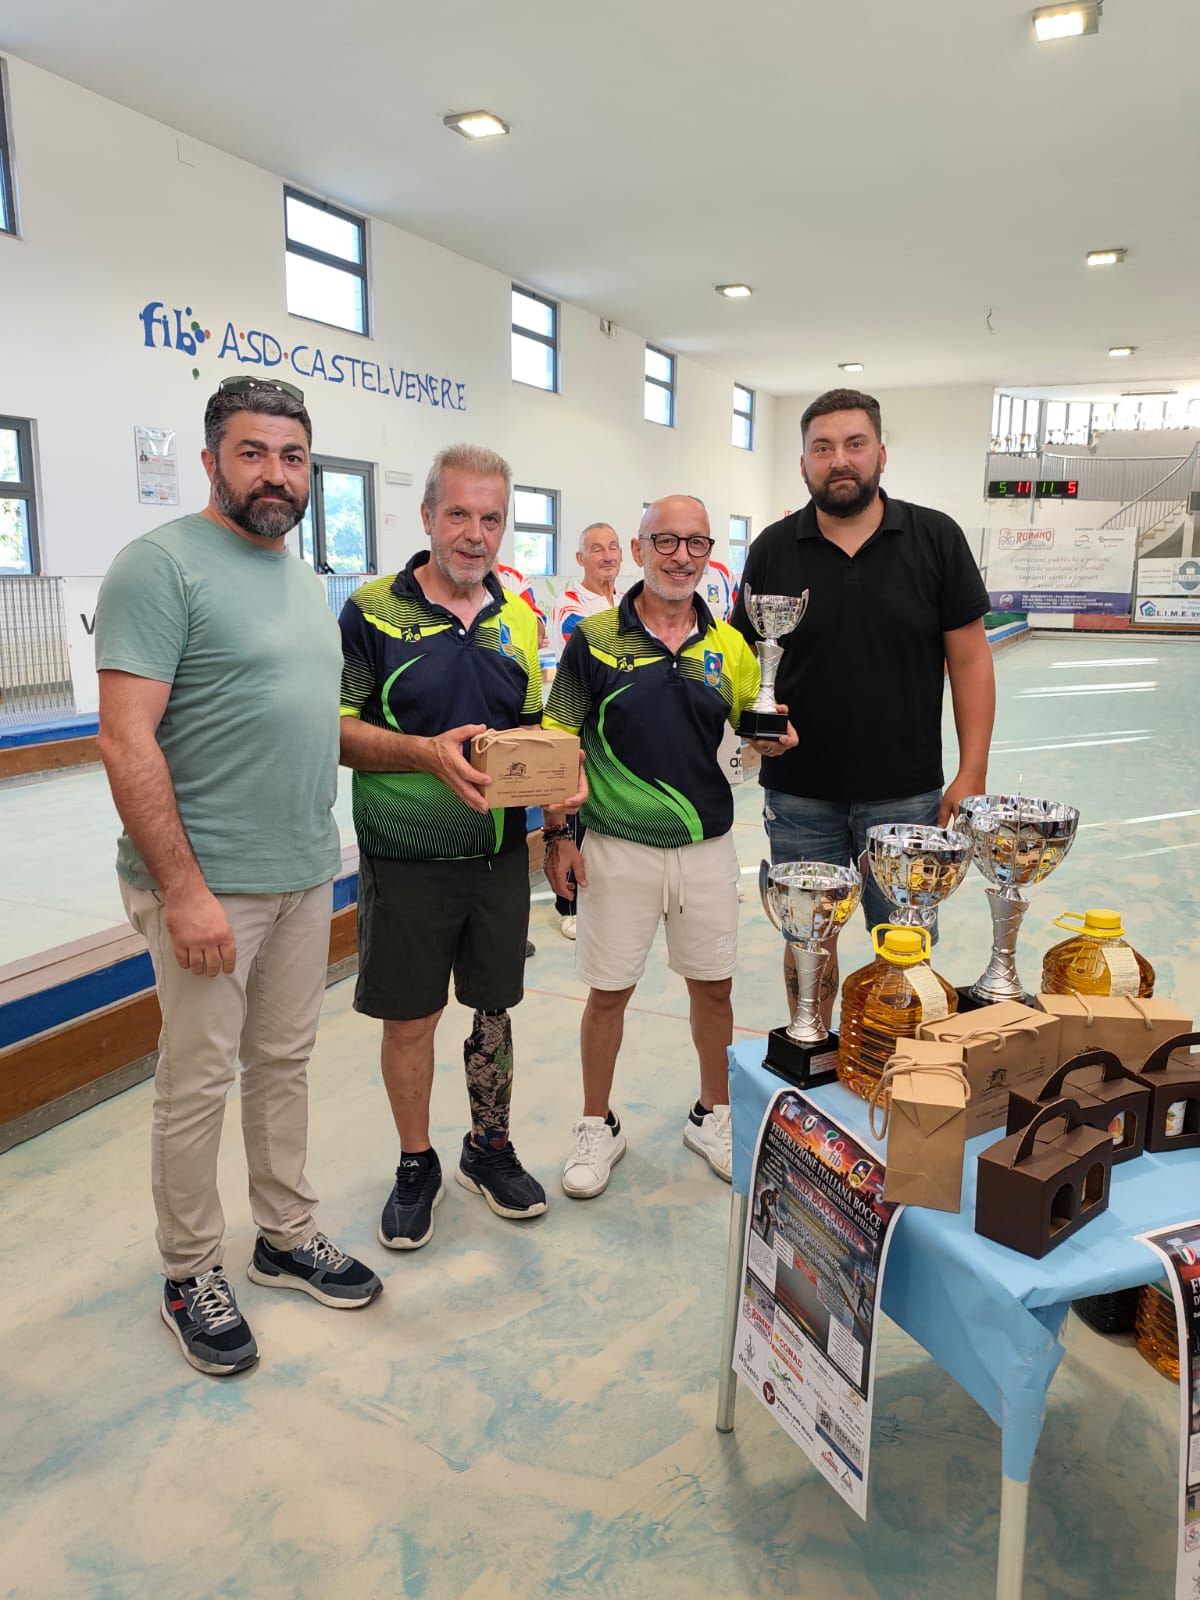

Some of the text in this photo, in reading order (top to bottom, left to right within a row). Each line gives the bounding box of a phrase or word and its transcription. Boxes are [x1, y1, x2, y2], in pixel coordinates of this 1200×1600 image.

[139, 301, 205, 356] fib
[999, 481, 1076, 493] 5 11 11 5
[1016, 530, 1051, 544] RUBANO
[770, 1120, 817, 1172] FEDERAZIONE
[817, 1162, 853, 1205] ITALIANA
[852, 1194, 881, 1231] BOCCE
[779, 1337, 802, 1369] CONAD
